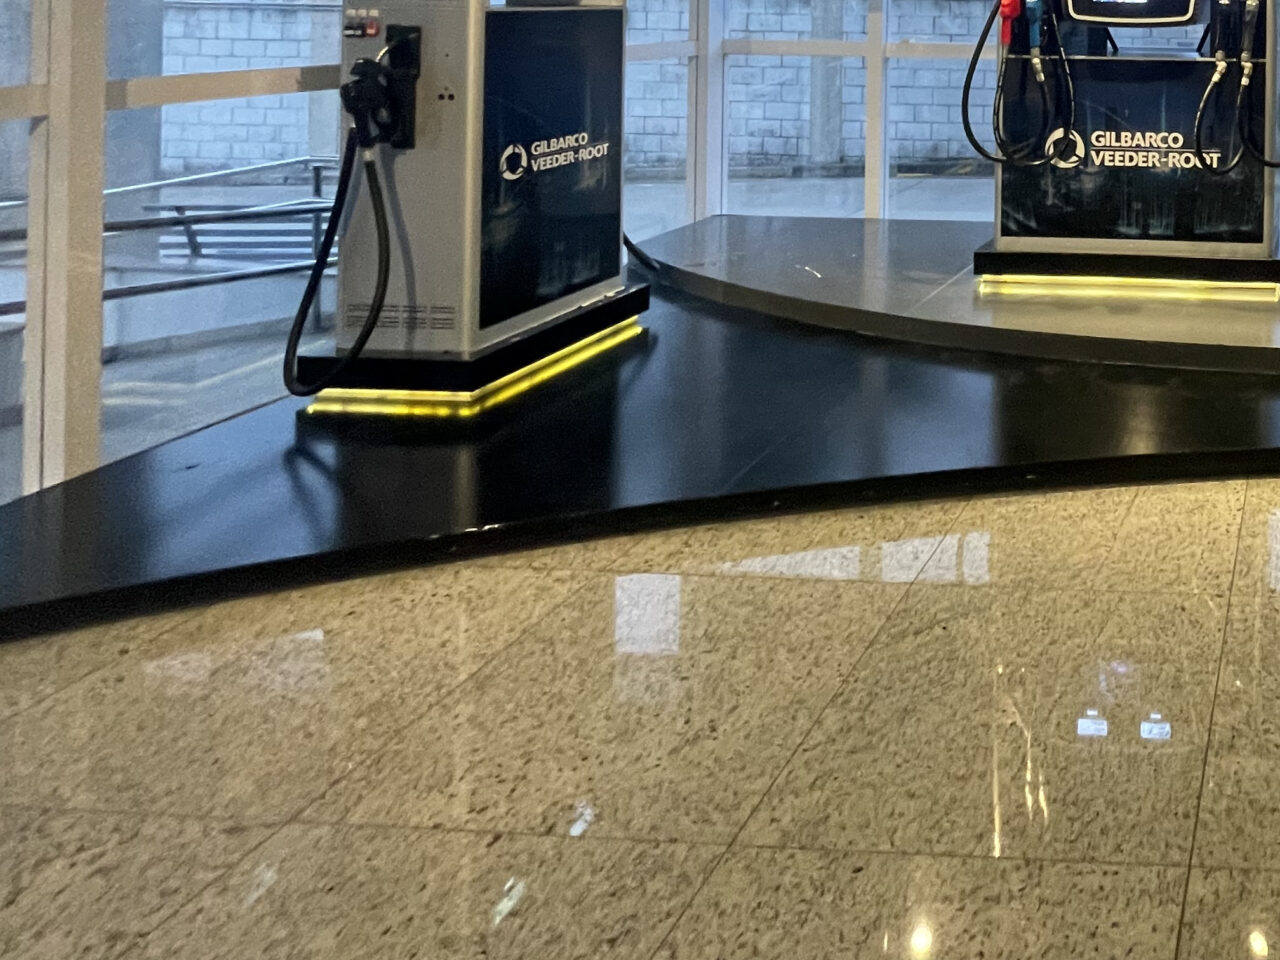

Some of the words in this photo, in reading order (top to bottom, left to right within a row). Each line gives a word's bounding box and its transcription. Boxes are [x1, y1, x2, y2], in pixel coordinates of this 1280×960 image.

[531, 132, 589, 156] GILBARCO
[1091, 130, 1184, 148] GILBARCO
[531, 142, 610, 173] VEEDER-ROOT
